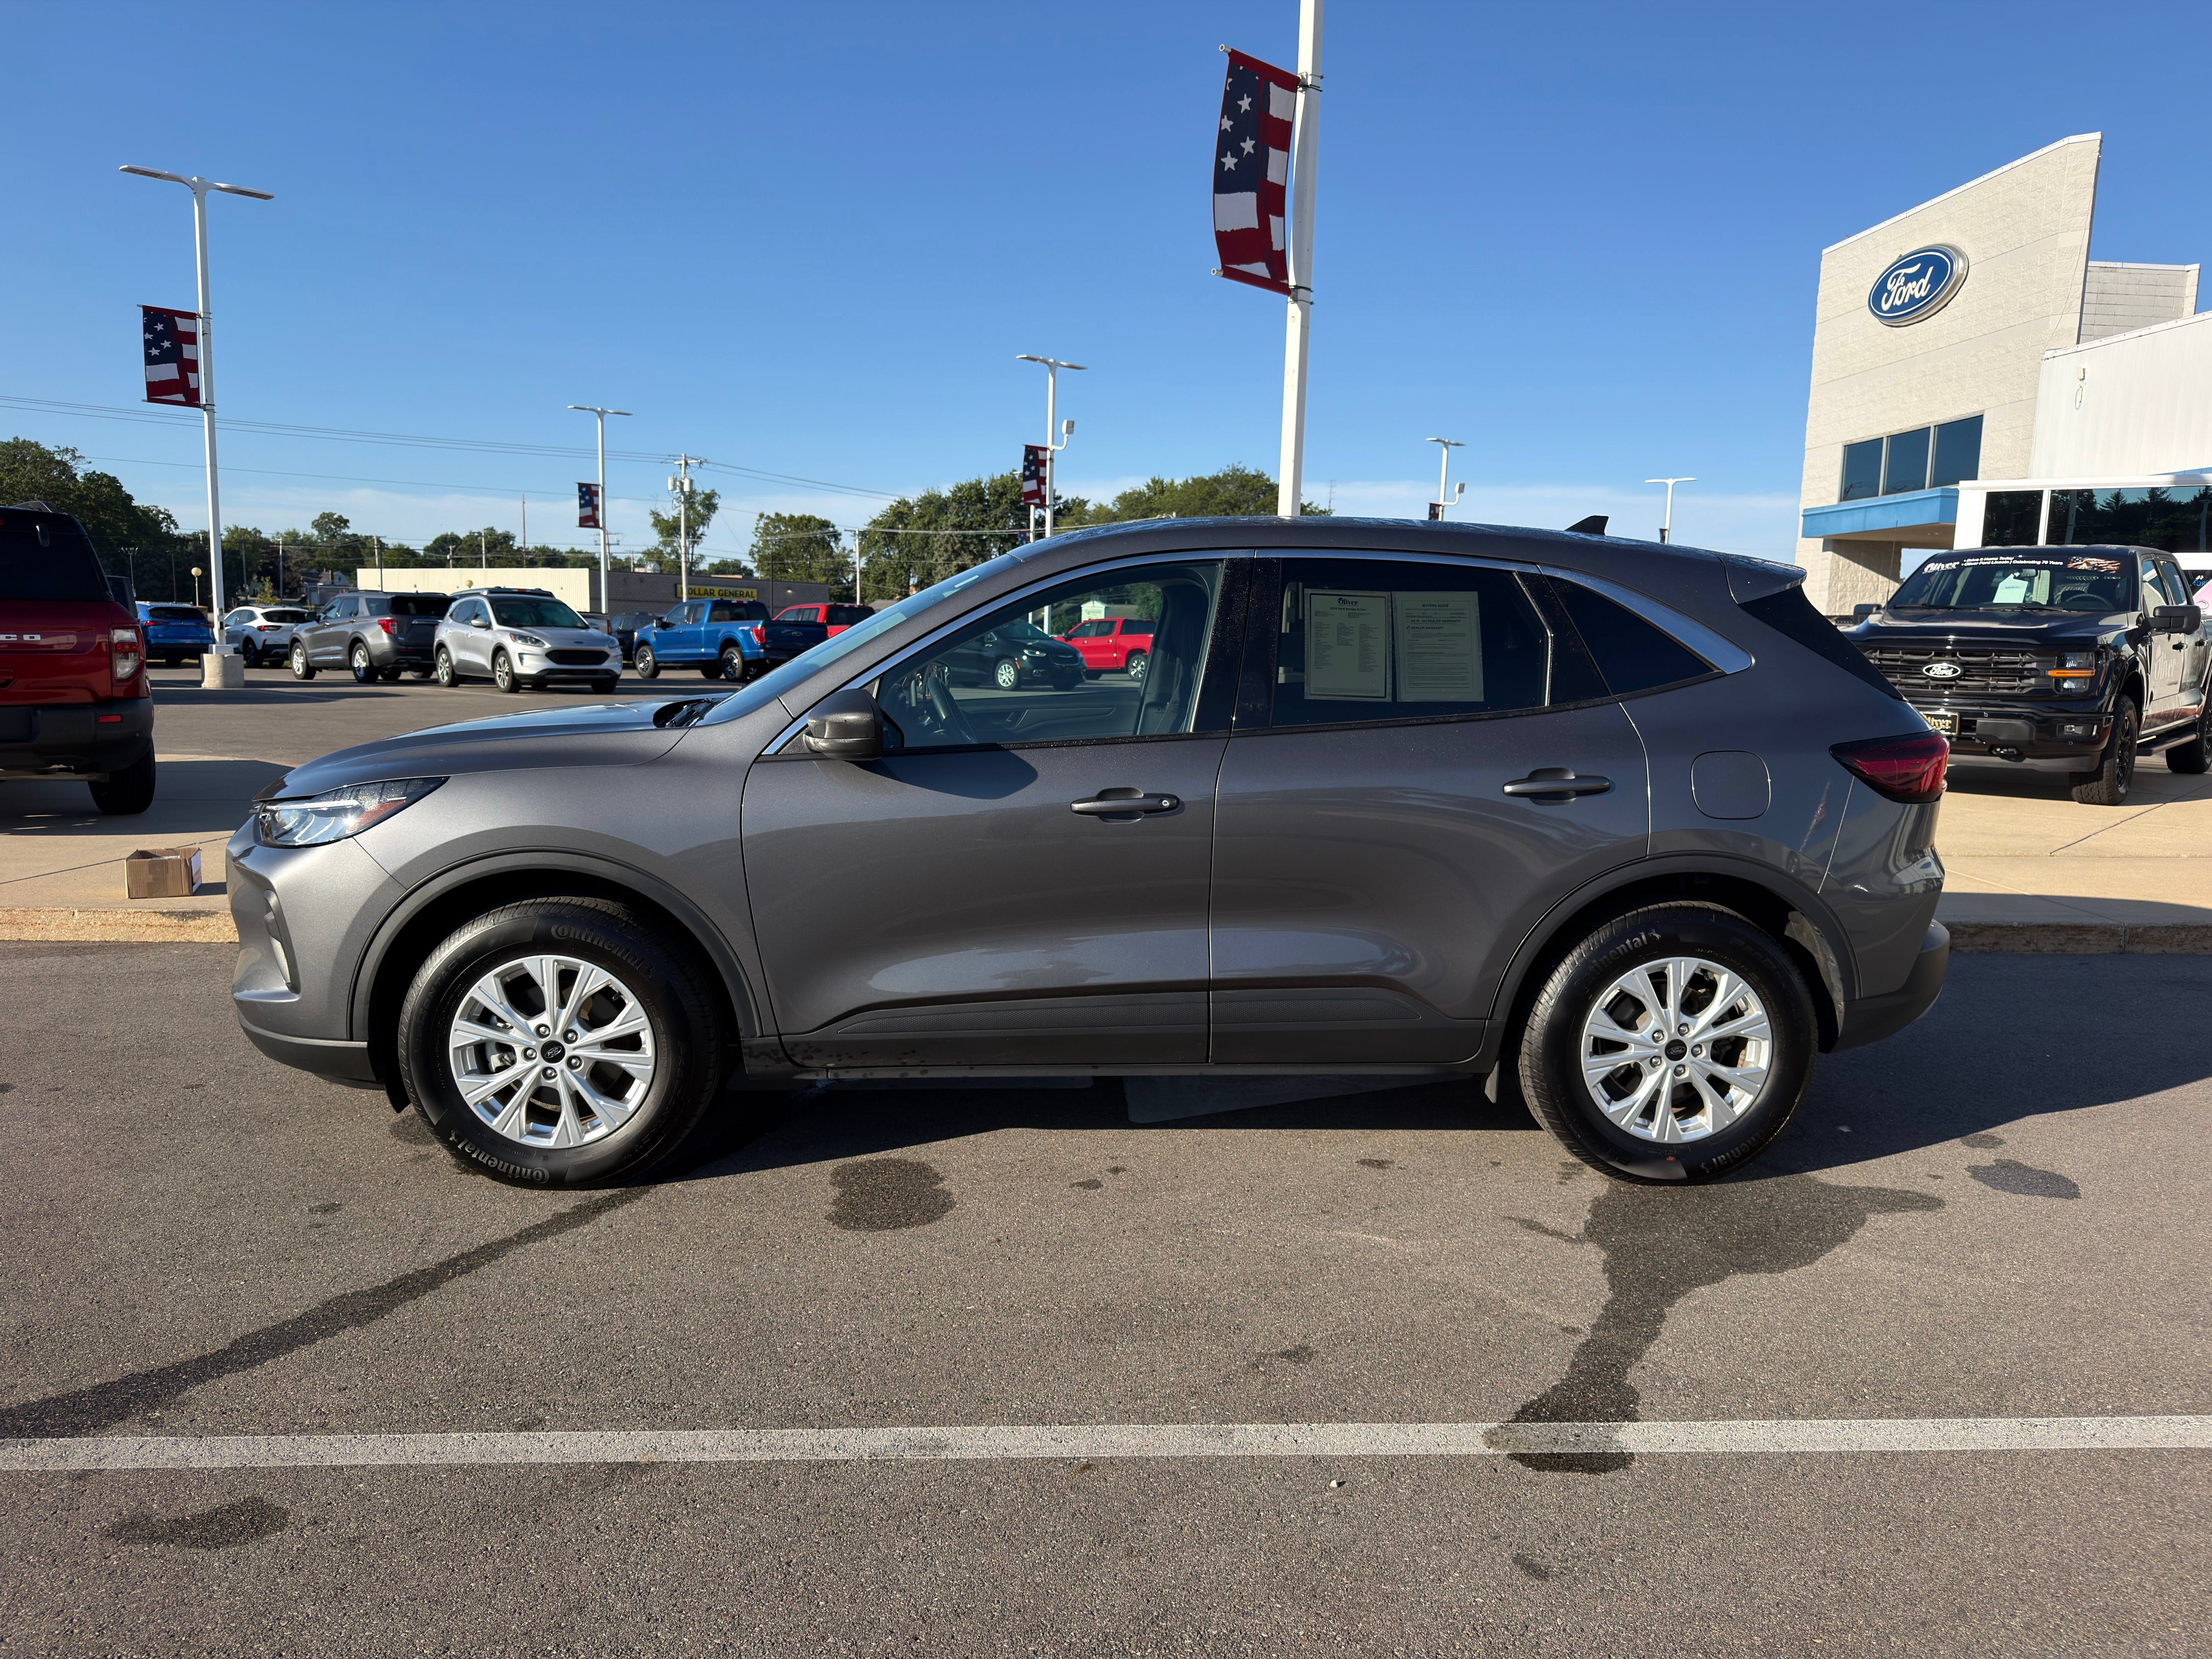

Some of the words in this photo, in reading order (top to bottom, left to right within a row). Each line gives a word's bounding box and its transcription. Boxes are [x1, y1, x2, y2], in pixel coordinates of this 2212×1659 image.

[1881, 263, 1934, 311] Ford
[681, 587, 714, 596] OLLAR
[718, 589, 755, 598] GENERAL
[1930, 666, 1953, 675] Ford
[551, 924, 646, 970] Continental
[548, 1048, 558, 1056] Ford
[457, 1139, 549, 1184] Continental
